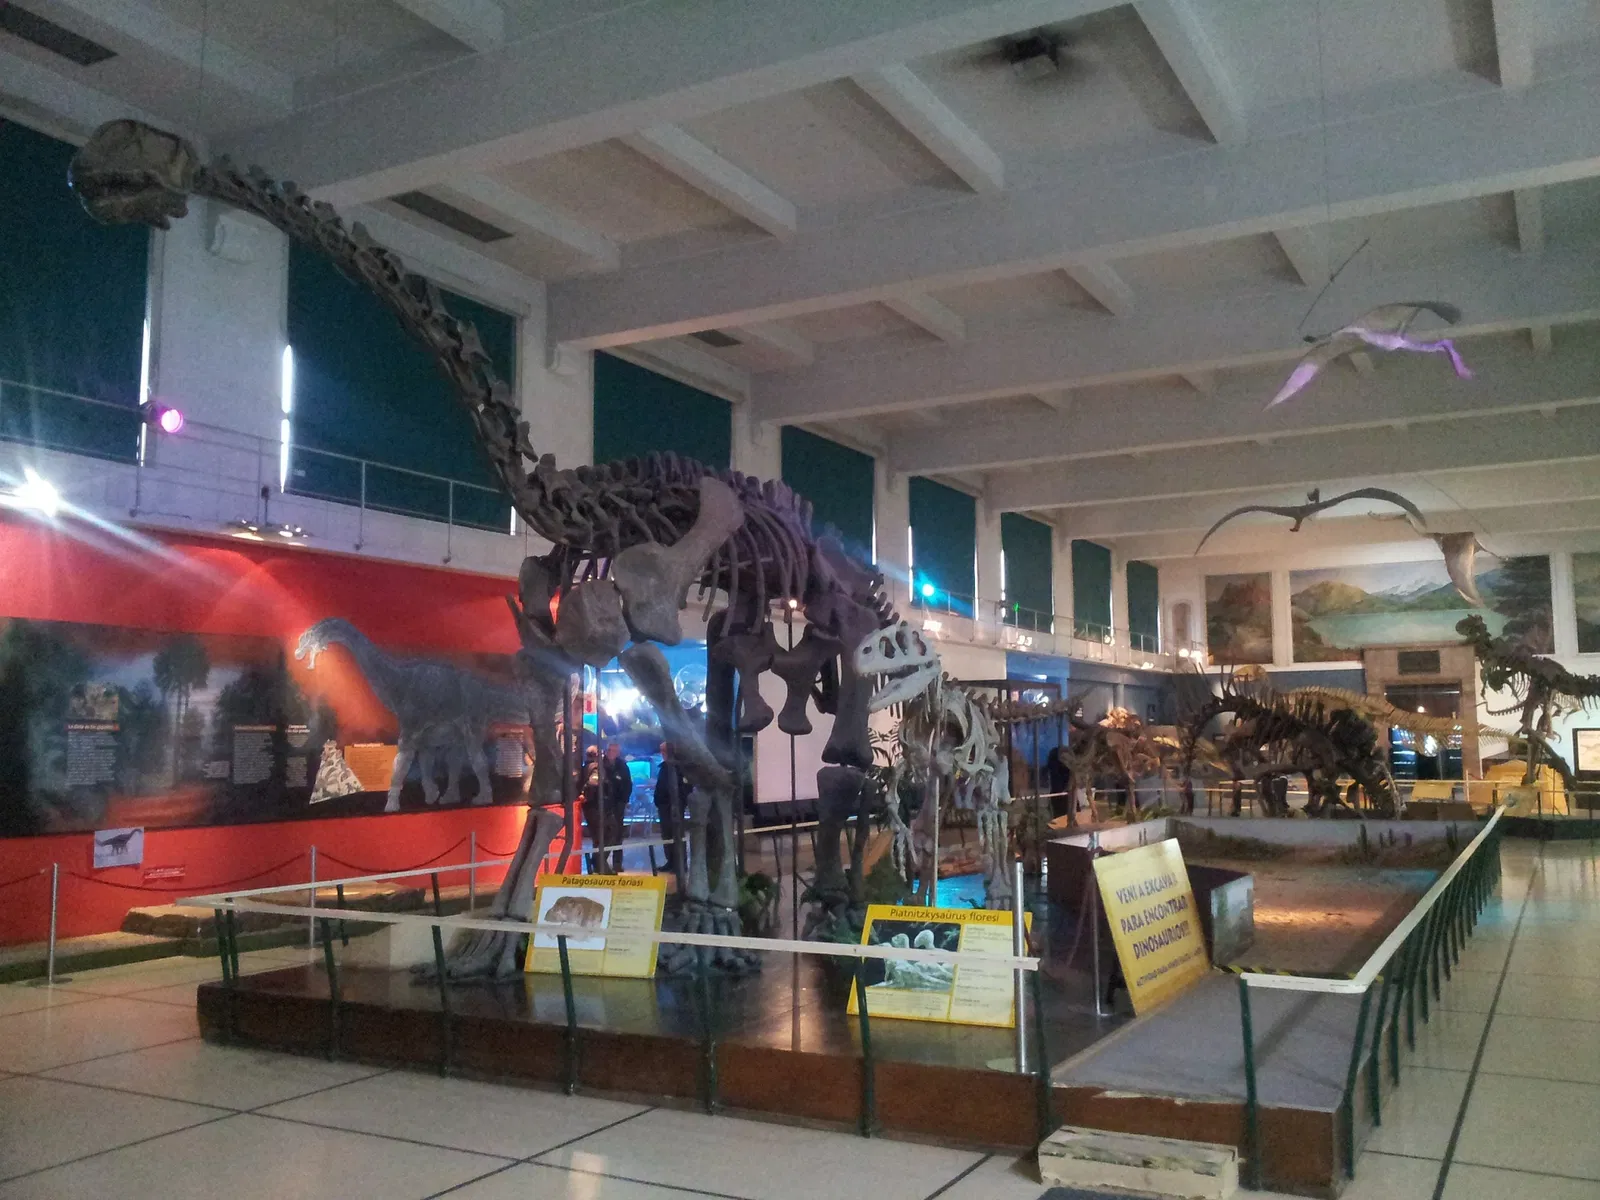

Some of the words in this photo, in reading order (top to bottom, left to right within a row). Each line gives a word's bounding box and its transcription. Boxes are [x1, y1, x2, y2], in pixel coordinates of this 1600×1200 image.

[561, 876, 616, 887] Patagosaurus
[618, 878, 644, 887] fariasi
[1138, 885, 1146, 898] A
[969, 911, 1000, 922] floresi
[1120, 913, 1145, 935] PARA
[1144, 895, 1189, 925] ENCONTRAR
